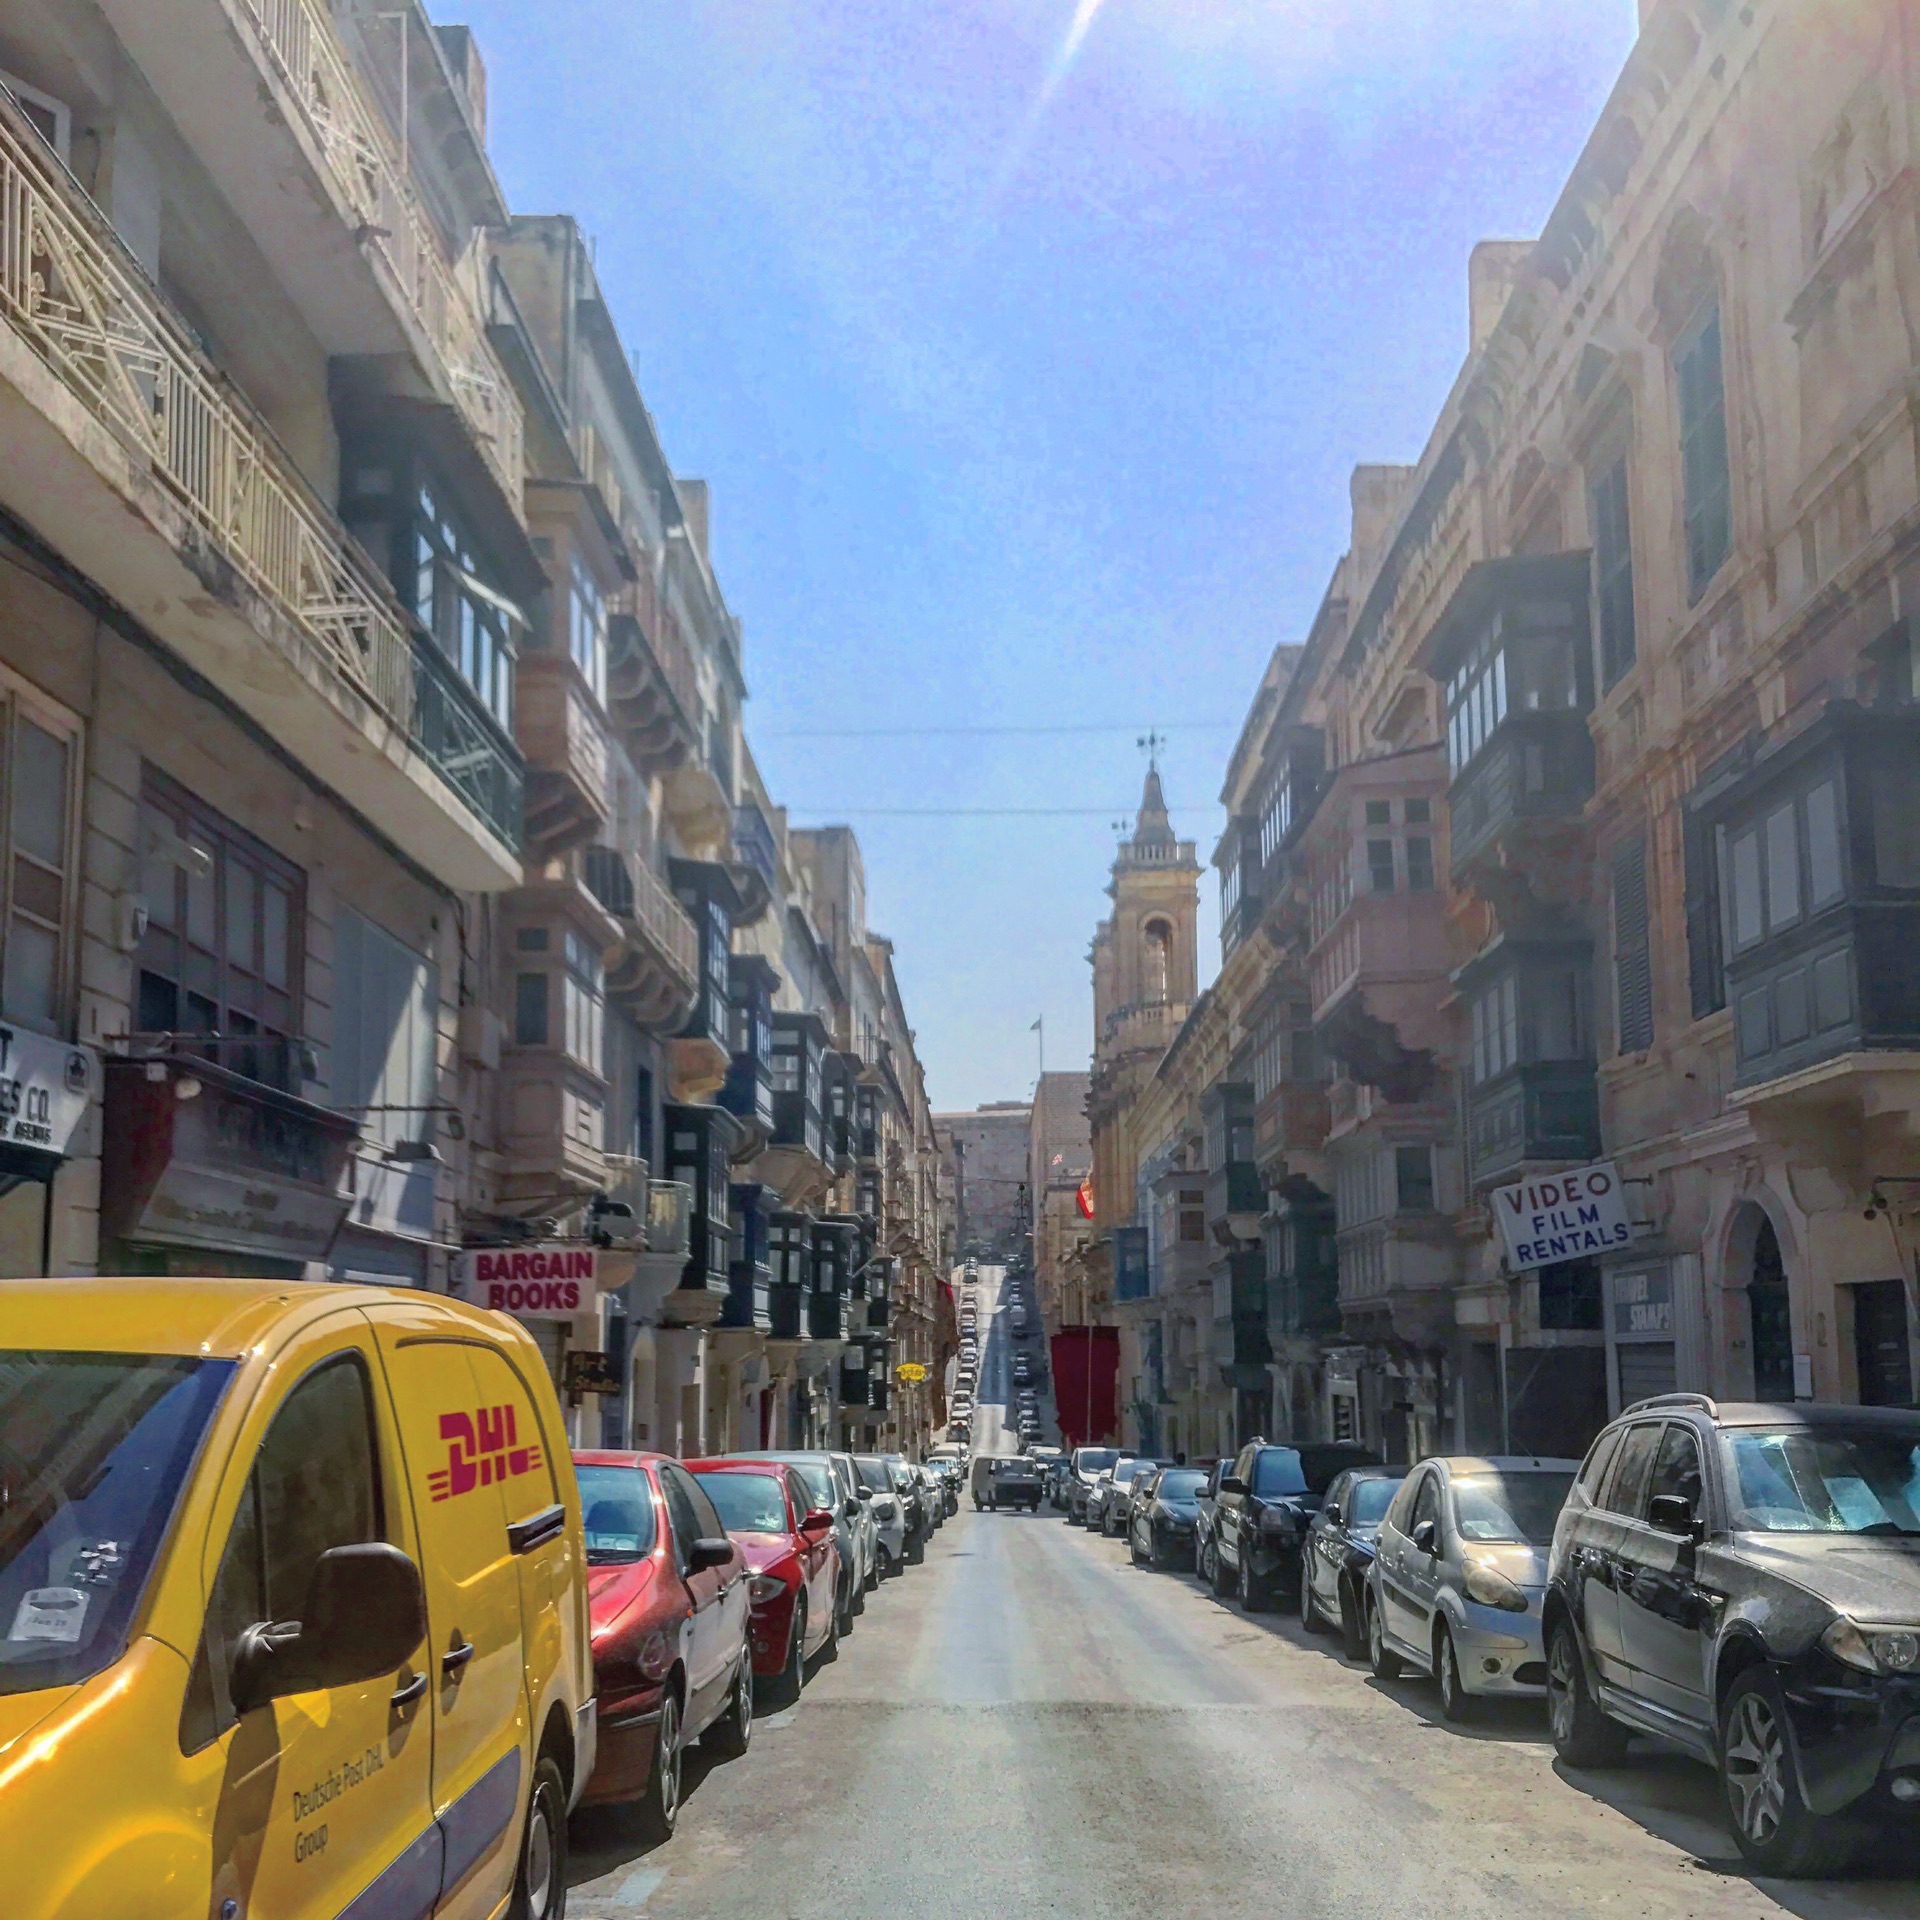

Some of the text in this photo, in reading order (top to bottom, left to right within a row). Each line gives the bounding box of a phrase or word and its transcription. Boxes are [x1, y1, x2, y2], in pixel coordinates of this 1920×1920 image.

[1504, 1172, 1611, 1215] VIDEO
[1532, 1203, 1600, 1235] FILM
[1516, 1222, 1629, 1264] RENTALS
[476, 1251, 593, 1281] BARGAIN
[488, 1281, 580, 1311] BOOKS
[439, 1404, 530, 1497] DHL
[293, 1743, 384, 1823] Deutsche Post DHL
[294, 1823, 329, 1864] Group
